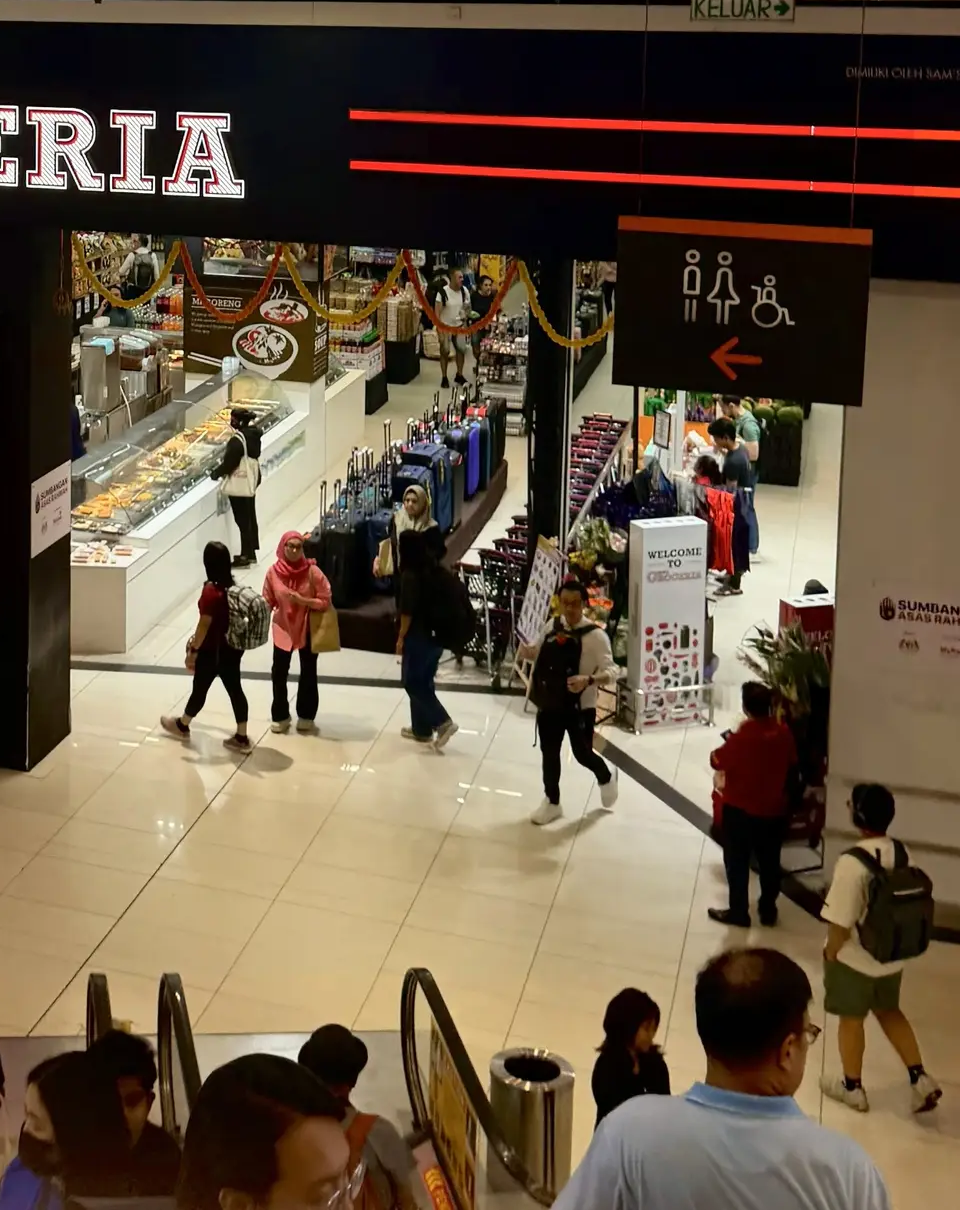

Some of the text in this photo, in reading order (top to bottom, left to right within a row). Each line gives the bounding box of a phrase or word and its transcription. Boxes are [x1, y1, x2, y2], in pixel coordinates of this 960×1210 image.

[891, 66, 923, 81] OLEH
[206, 298, 242, 308] ORENG
[647, 547, 703, 560] WELCOME
[667, 558, 682, 568] TO
